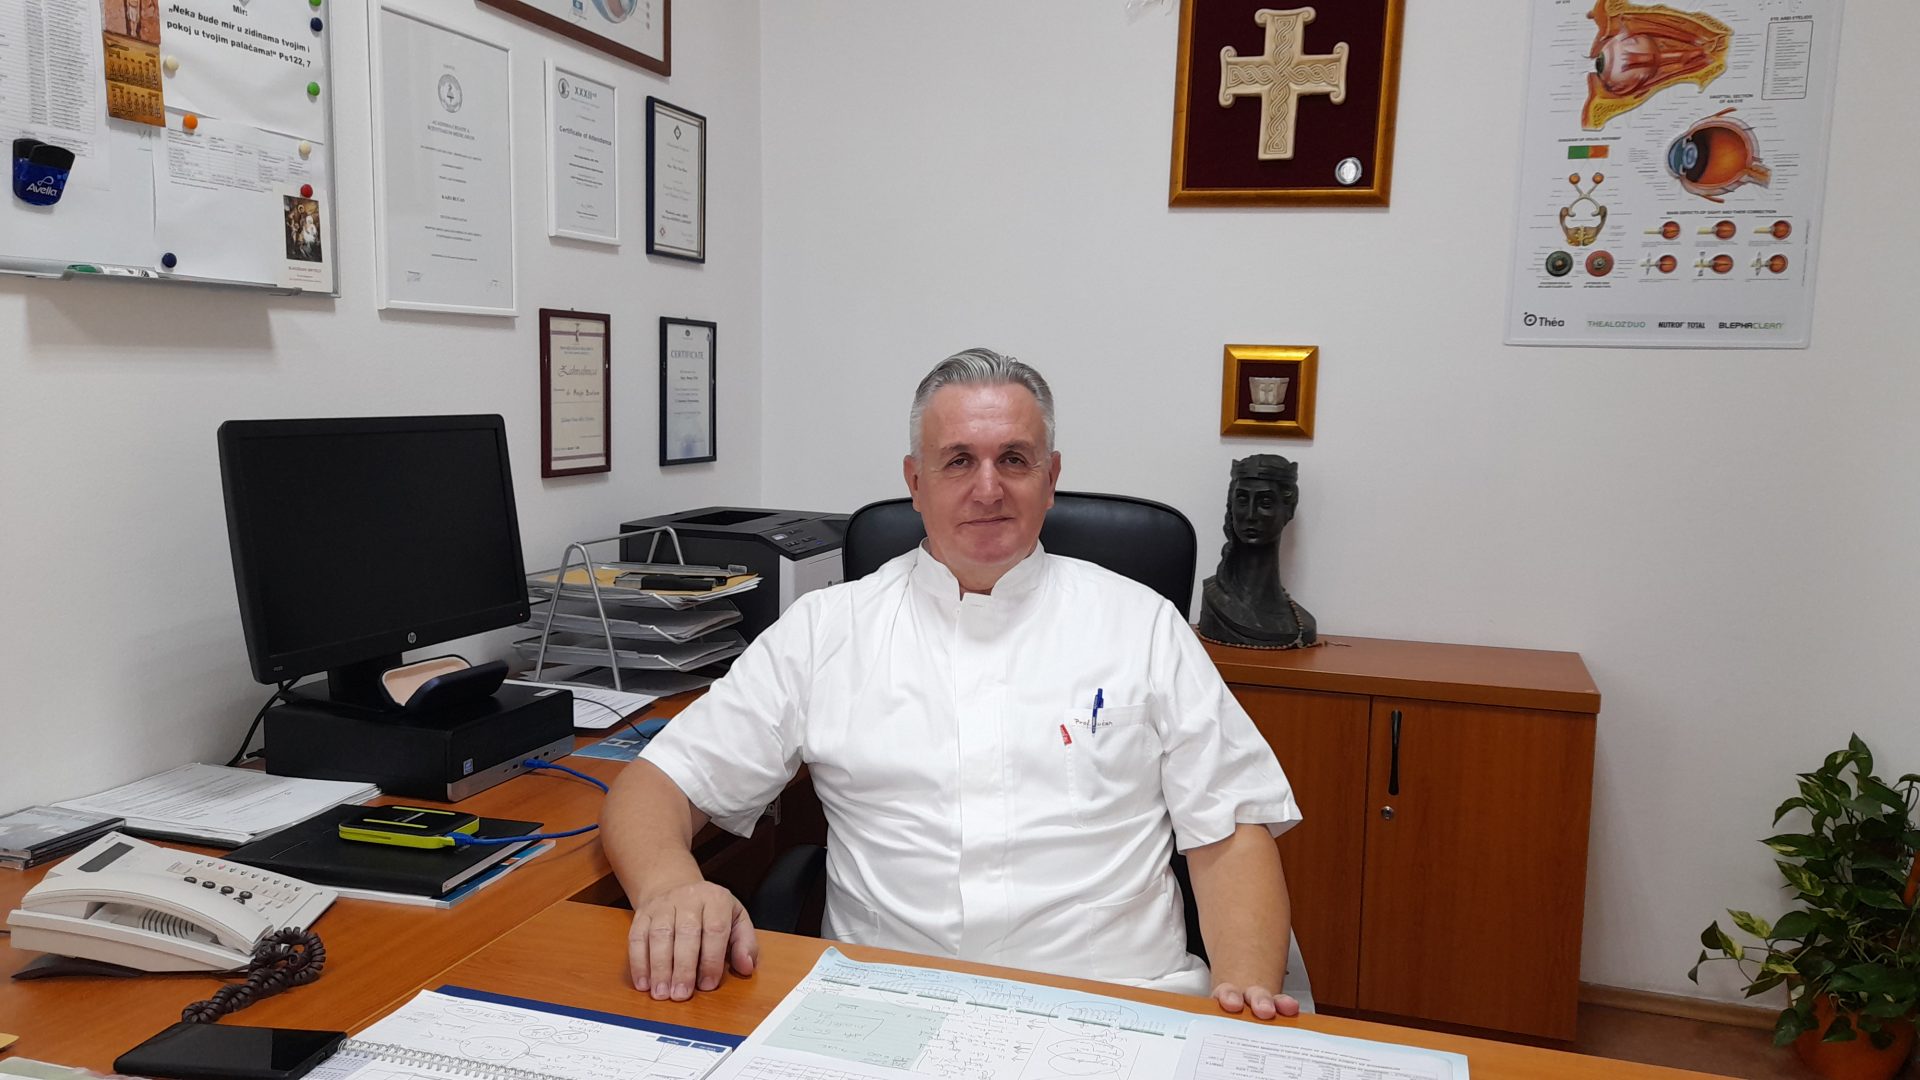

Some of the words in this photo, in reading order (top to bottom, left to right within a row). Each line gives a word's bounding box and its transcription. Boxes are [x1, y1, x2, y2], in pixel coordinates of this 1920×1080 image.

[233, 4, 248, 16] Mir:
[198, 12, 219, 25] bude
[221, 21, 235, 30] mir
[244, 28, 280, 44] zidinama
[282, 39, 306, 51] tvojim
[167, 20, 191, 35] pokoj
[202, 31, 229, 45] tvojim
[306, 60, 311, 68] 7
[26, 182, 57, 197] Avella
[1539, 316, 1565, 327] Théa
[1658, 321, 1683, 329] NUTROF
[1687, 321, 1705, 329] TOTAL
